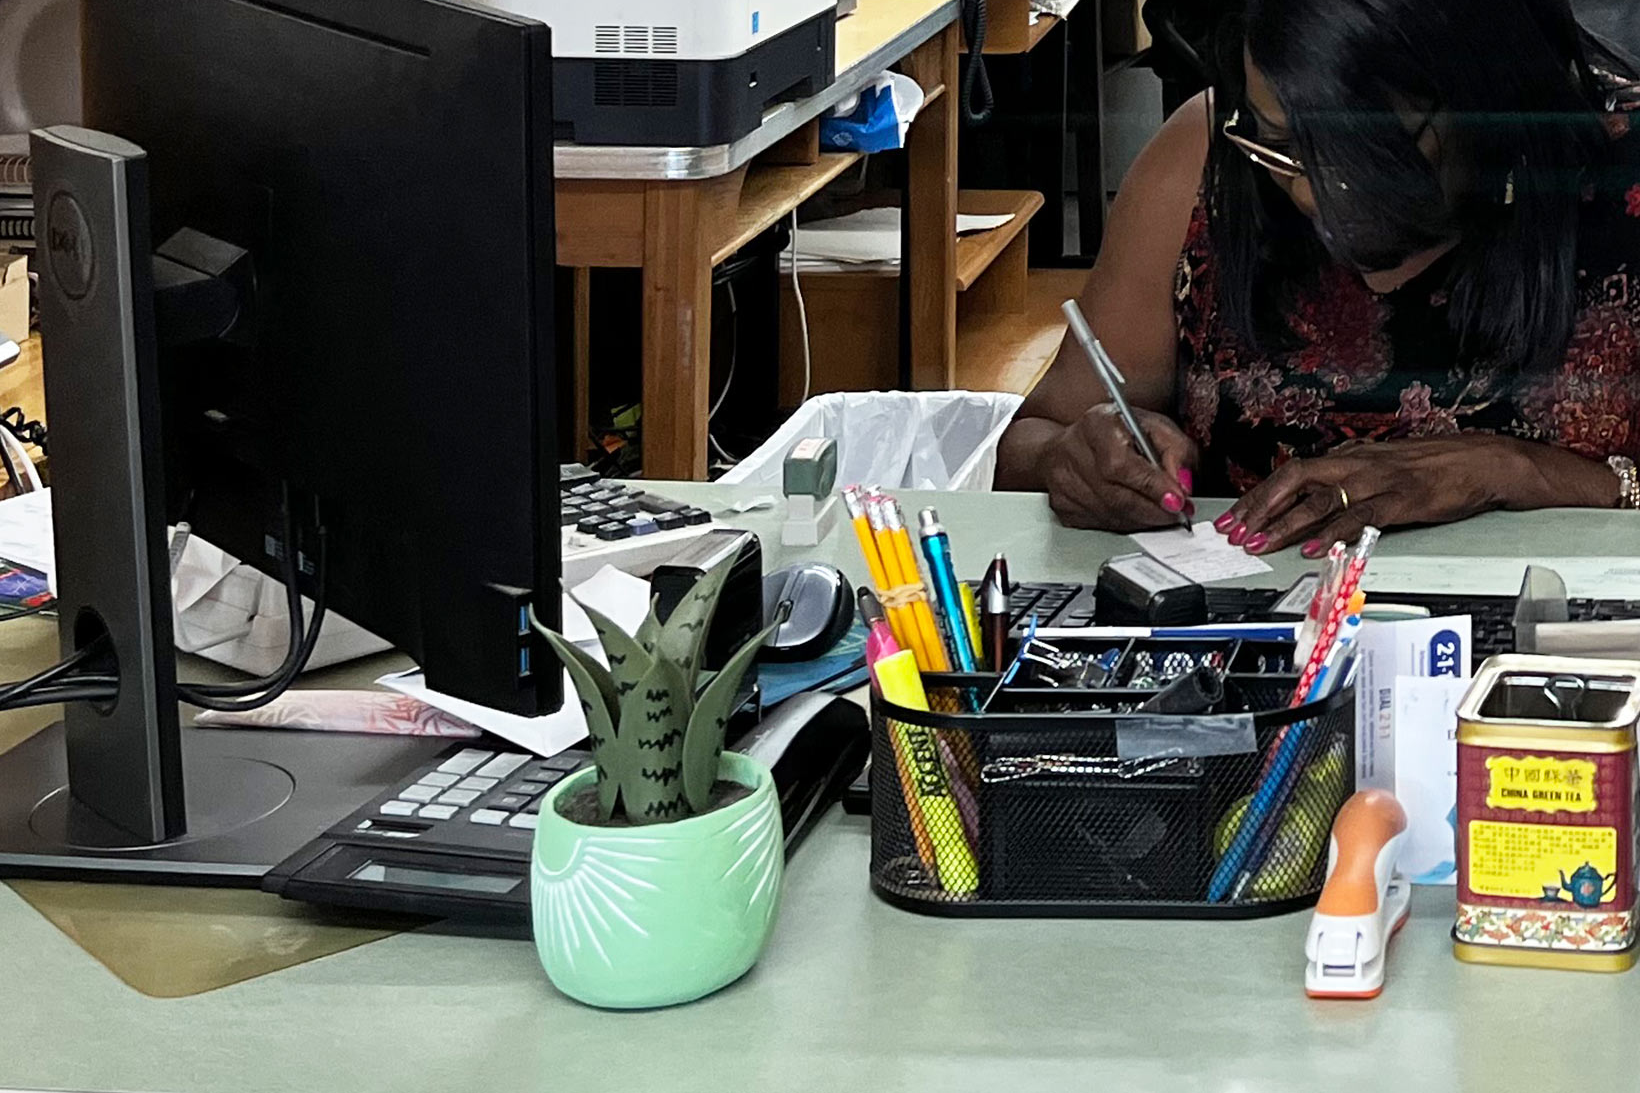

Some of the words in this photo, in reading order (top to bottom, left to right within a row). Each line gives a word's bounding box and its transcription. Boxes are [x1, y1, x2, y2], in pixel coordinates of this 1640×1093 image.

[1378, 688, 1392, 711] DIAL
[1501, 787, 1529, 799] CHINA
[1532, 789, 1562, 801] GREEN
[1565, 790, 1582, 802] TEA
